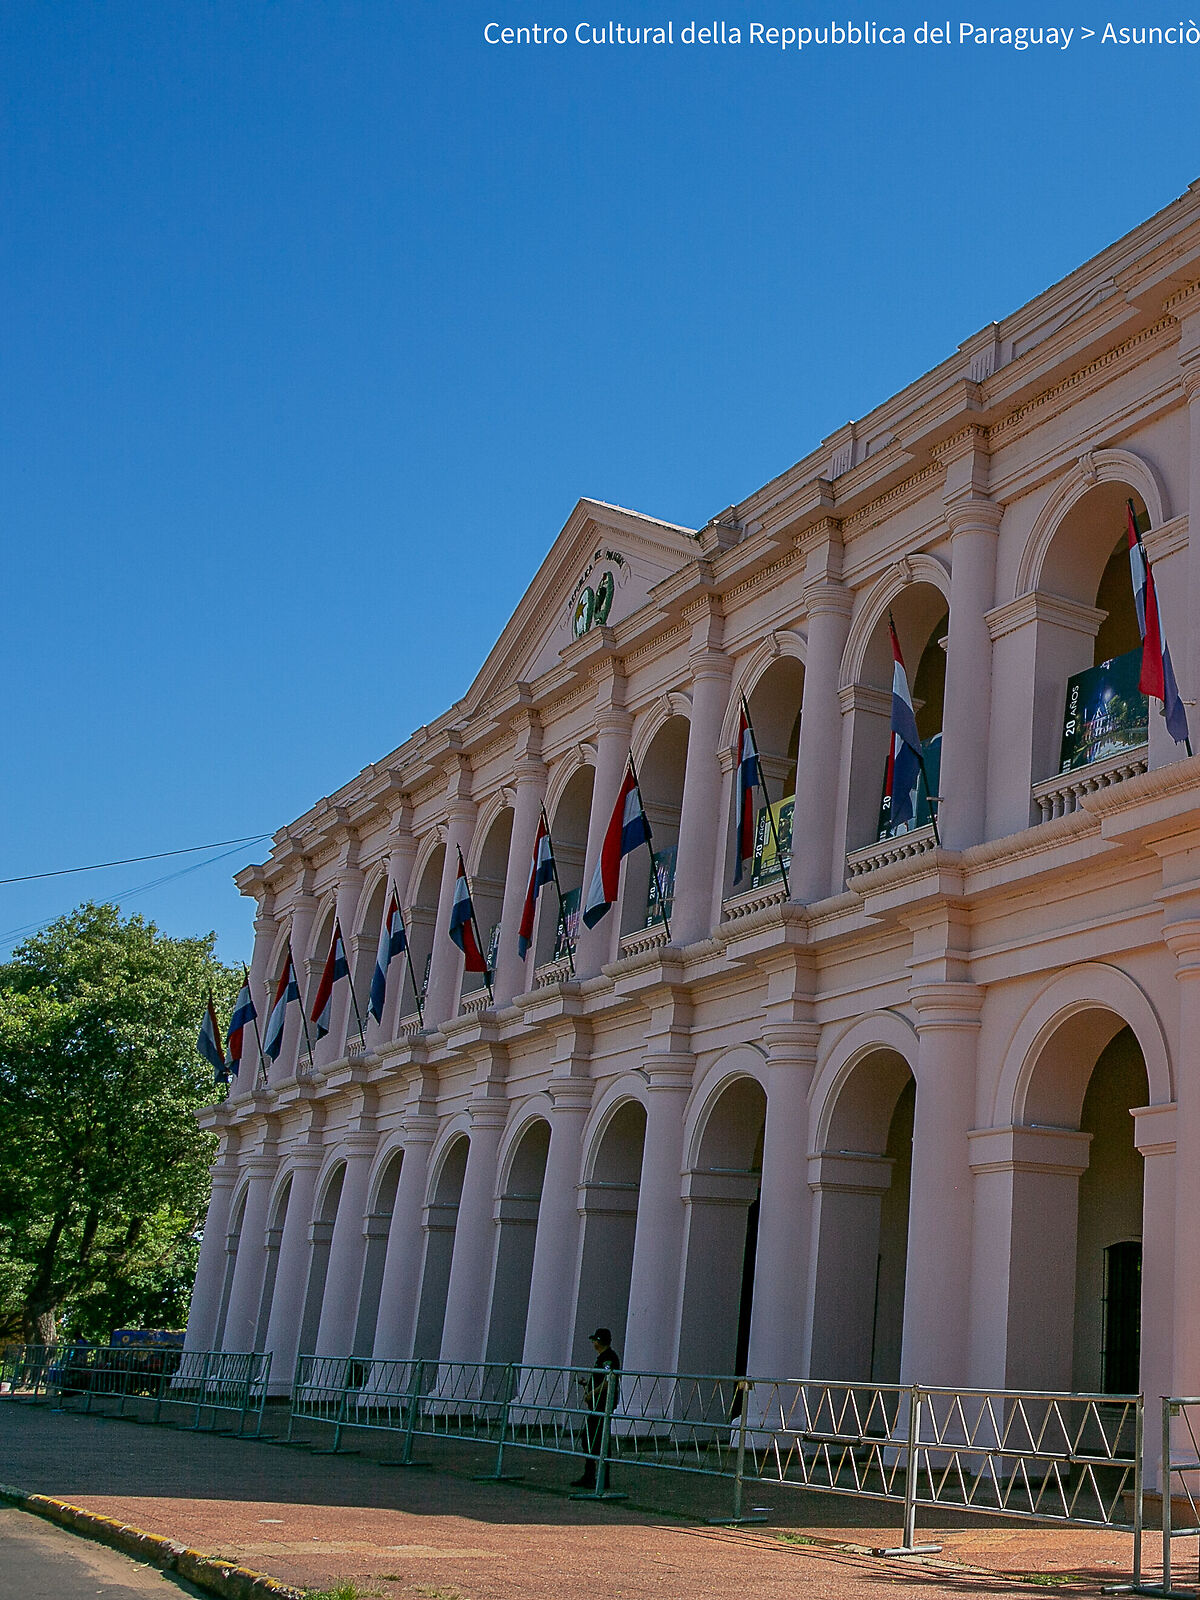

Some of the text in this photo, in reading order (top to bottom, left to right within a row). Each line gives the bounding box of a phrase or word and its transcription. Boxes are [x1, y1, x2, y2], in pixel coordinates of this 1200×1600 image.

[1065, 685, 1079, 736] 20 AÑOS
[882, 795, 892, 810] 20
[755, 844, 763, 858] 20
[649, 886, 656, 900] 20
